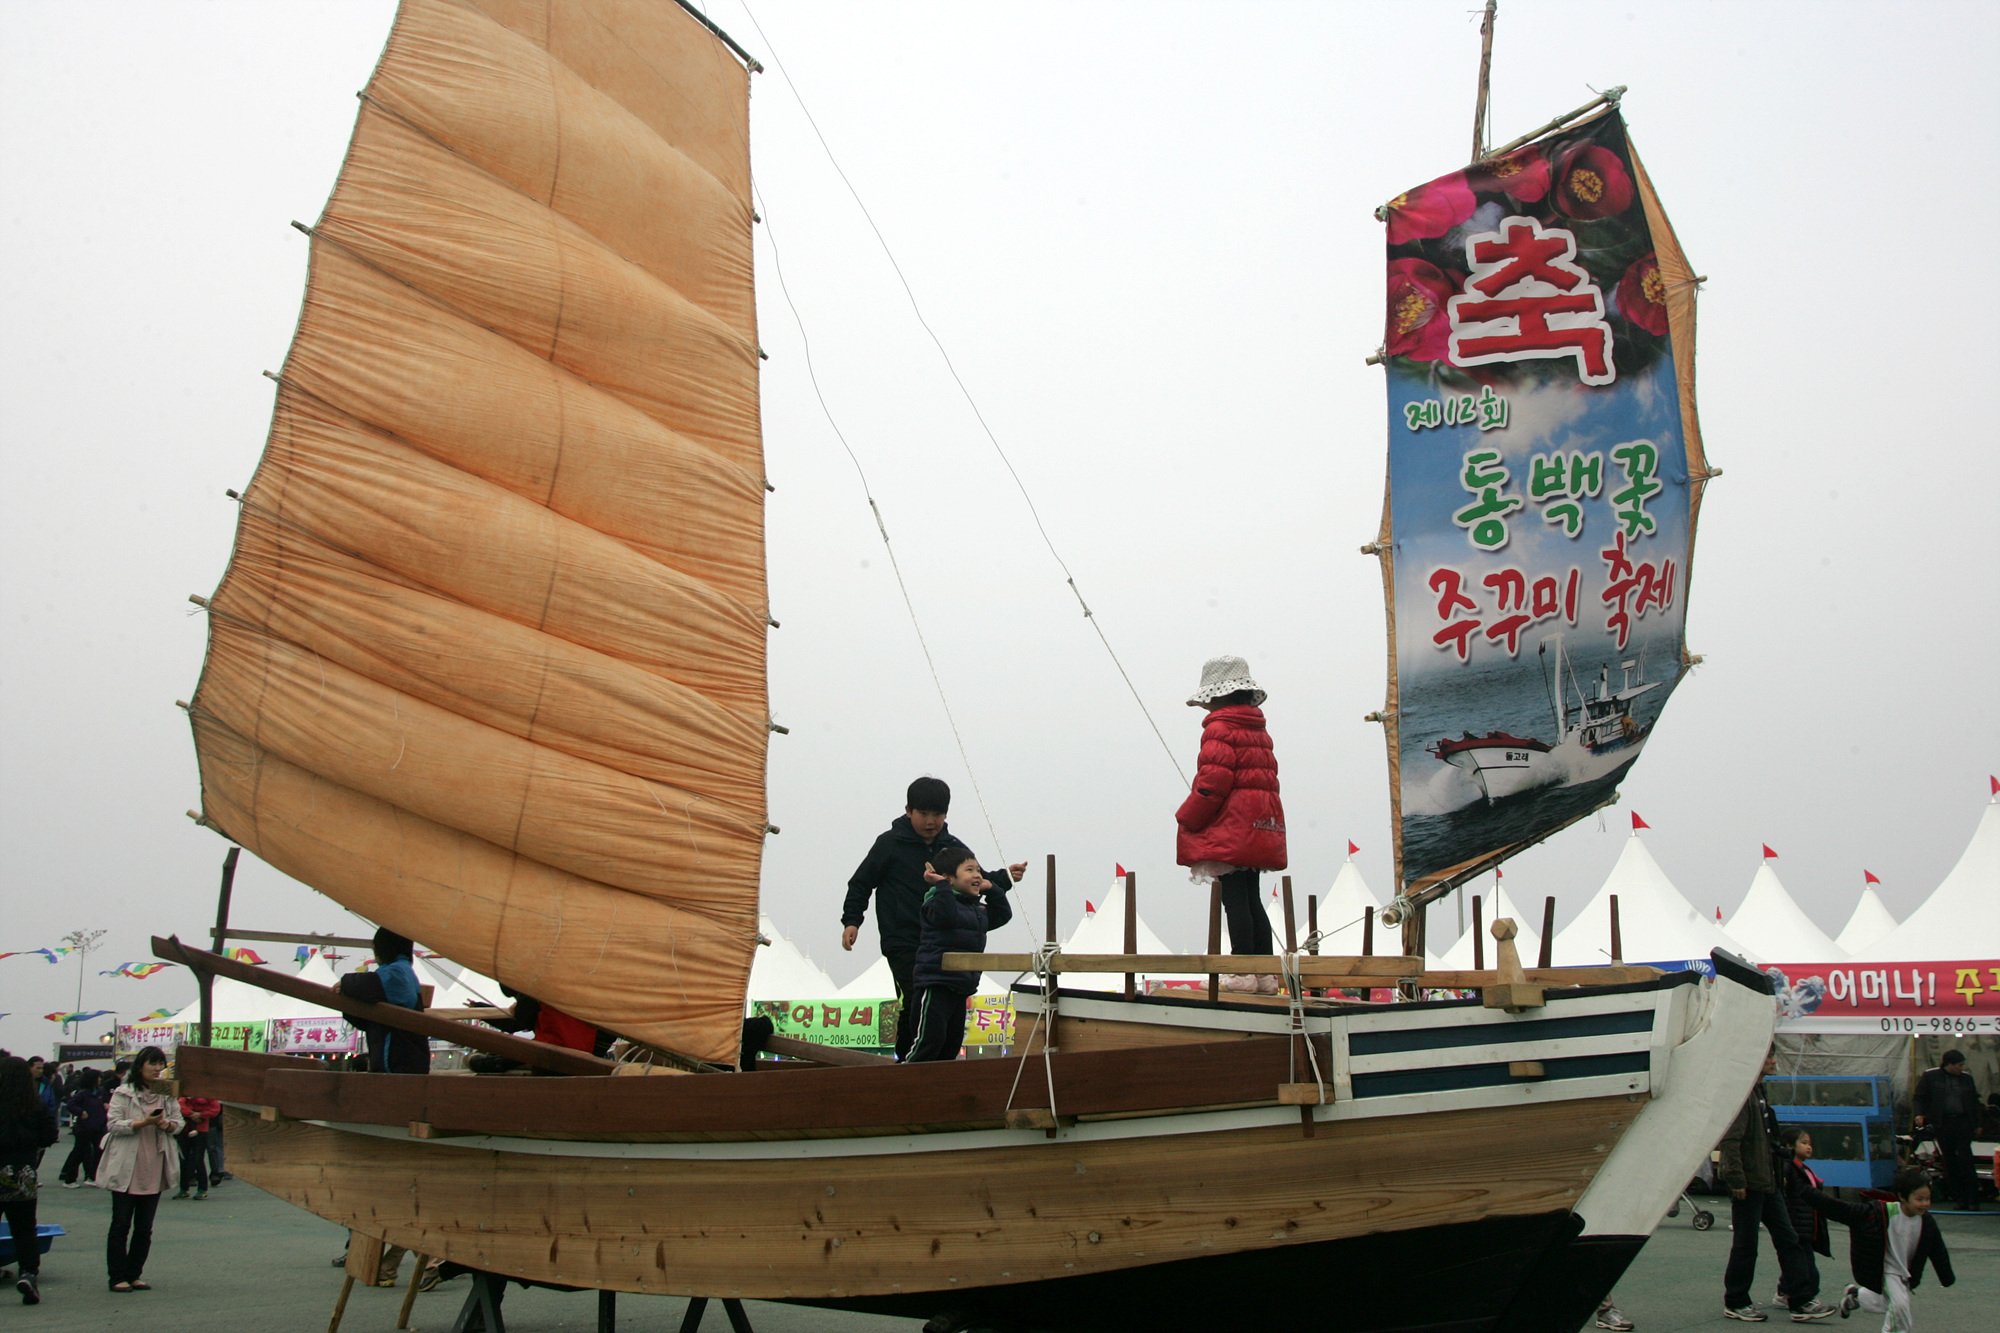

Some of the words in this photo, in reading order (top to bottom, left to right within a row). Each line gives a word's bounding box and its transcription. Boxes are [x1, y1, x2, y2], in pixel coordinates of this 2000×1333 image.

[1449, 217, 1615, 385] 축
[1404, 386, 1508, 429] 제12회
[1454, 440, 1662, 549] 동백꽃
[1427, 567, 1582, 662] 주꾸미
[1600, 531, 1677, 650] 축제
[1828, 969, 1937, 1007] 어머나!
